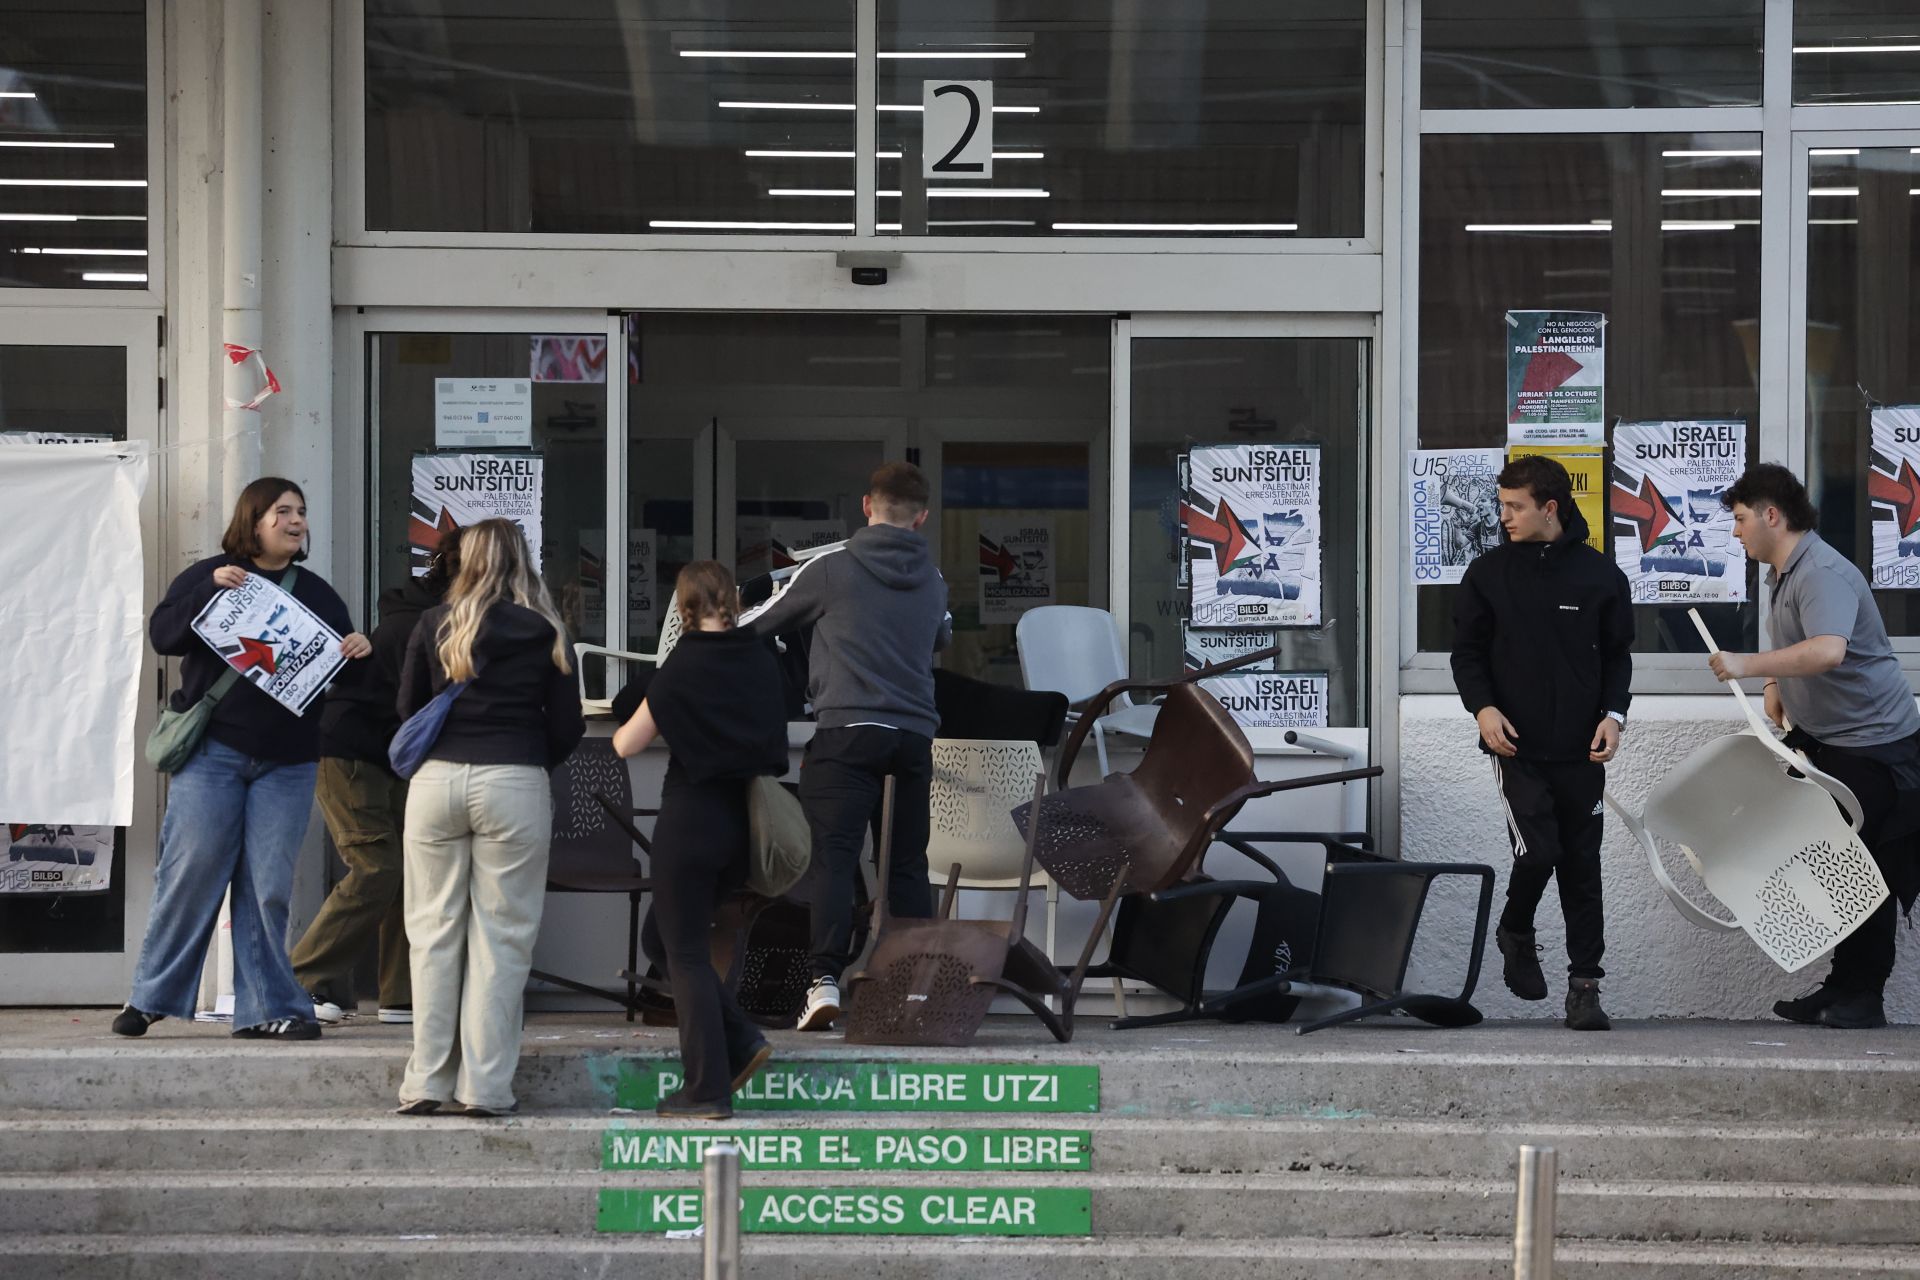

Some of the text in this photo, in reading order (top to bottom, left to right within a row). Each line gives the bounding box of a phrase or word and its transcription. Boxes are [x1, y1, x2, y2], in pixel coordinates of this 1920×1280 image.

[932, 84, 984, 172] 2
[1673, 427, 1736, 442] ISRAEL
[1248, 450, 1311, 466] ISRAEL
[1635, 443, 1736, 459] SUNTSITU!
[471, 460, 533, 475] ISRAEL
[1413, 458, 1448, 476] U15
[1448, 455, 1488, 466] IKASLE
[1212, 466, 1310, 482] SUNTSITU!
[1448, 466, 1495, 477] GREBA!
[434, 476, 533, 491] SUNTSITU!
[1246, 491, 1310, 499] ERRESISTENTZIA
[1414, 480, 1428, 579] GENOZIDIOA
[1428, 509, 1441, 579] GELDITU!
[1876, 565, 1919, 586] U15
[1661, 581, 1688, 590] BILBO
[1196, 604, 1237, 623] U15
[1239, 605, 1266, 614] BILBO
[1200, 637, 1268, 648] SUNTSITU!
[268, 632, 328, 698] MOBILIZAZIOA
[1256, 680, 1318, 695] ISRAEL
[1220, 696, 1318, 711] SUNTSITU!
[33, 872, 60, 880] BILBO
[872, 1073, 966, 1101] LIBRE
[984, 1074, 1058, 1103] UTZI
[819, 1136, 861, 1164] EL
[876, 1136, 967, 1164] PASO
[984, 1136, 1081, 1164] LIBRE
[652, 1195, 1036, 1225] KE ACCESS CLEAR
